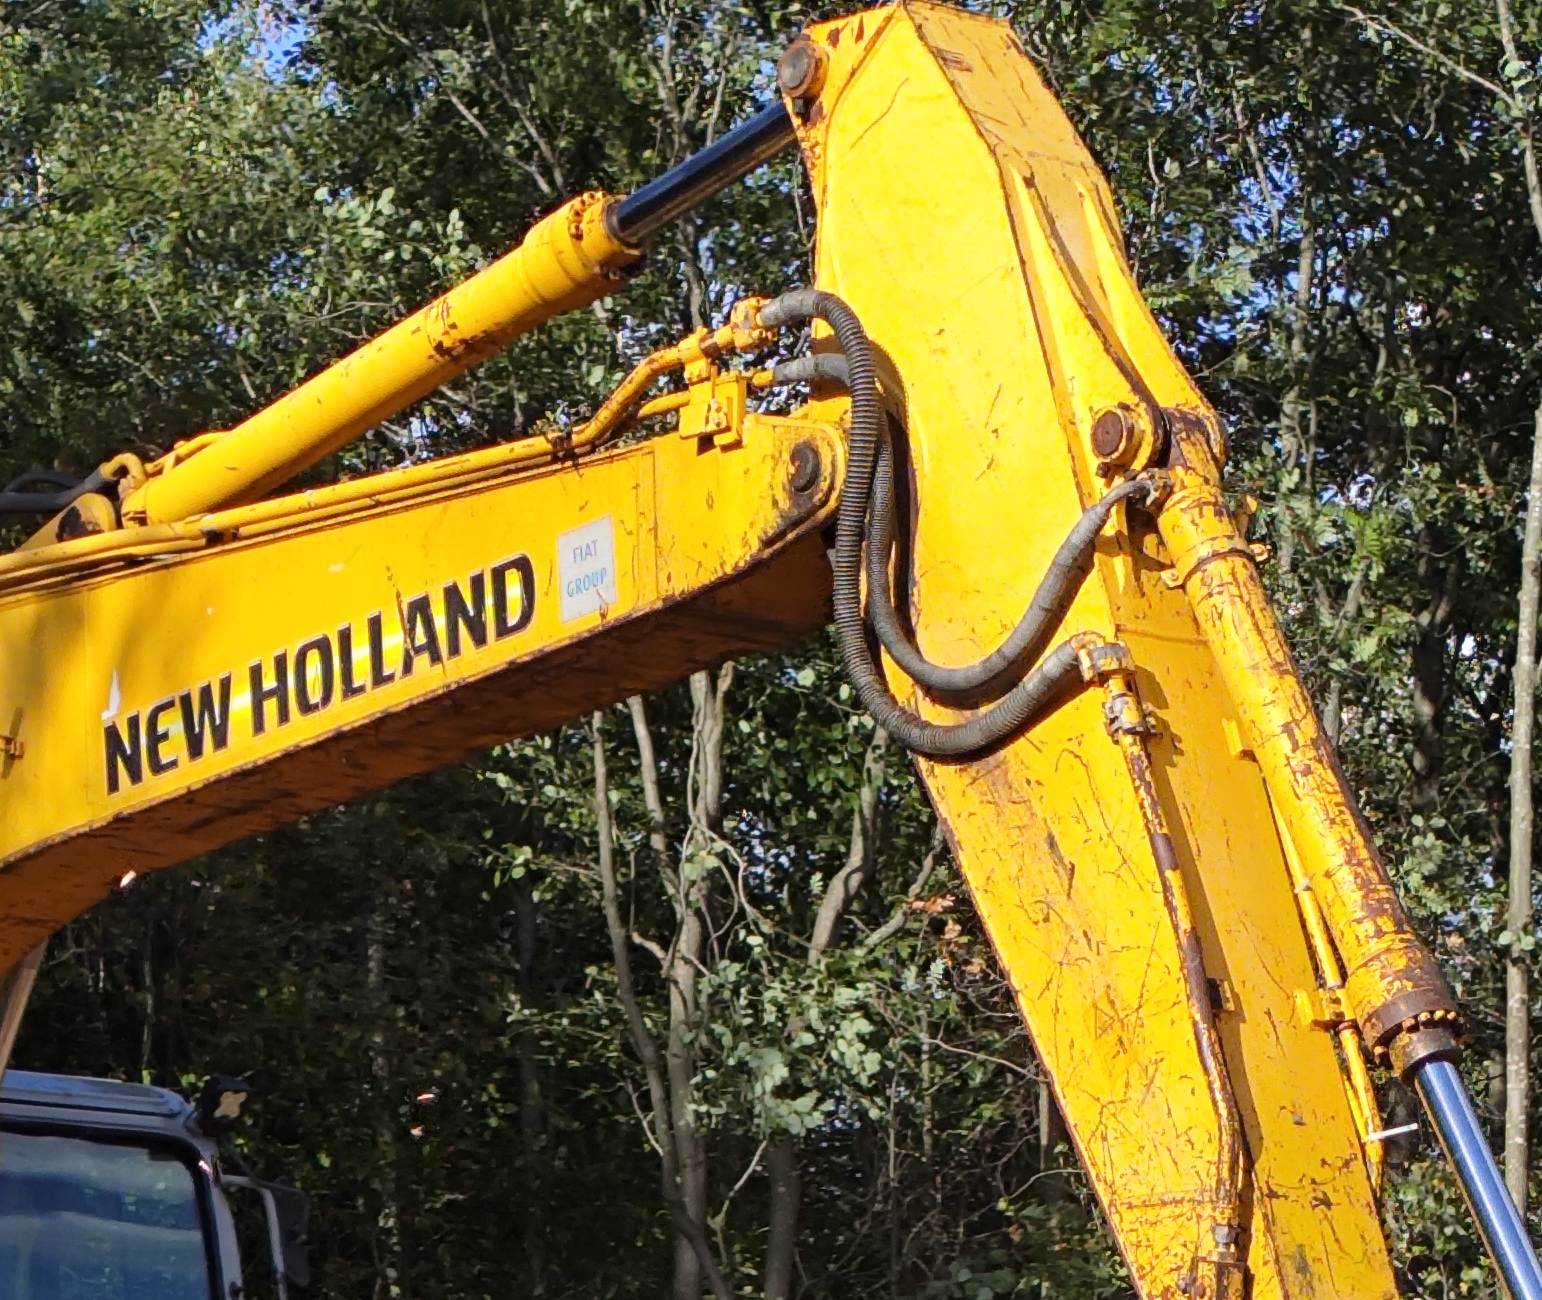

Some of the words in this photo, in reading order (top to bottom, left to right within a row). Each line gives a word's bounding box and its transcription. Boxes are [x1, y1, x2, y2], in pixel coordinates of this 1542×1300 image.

[573, 540, 598, 564] FIAT
[567, 568, 607, 598] GROUP
[104, 672, 232, 796] NEW
[248, 553, 536, 737] HOLLAND
